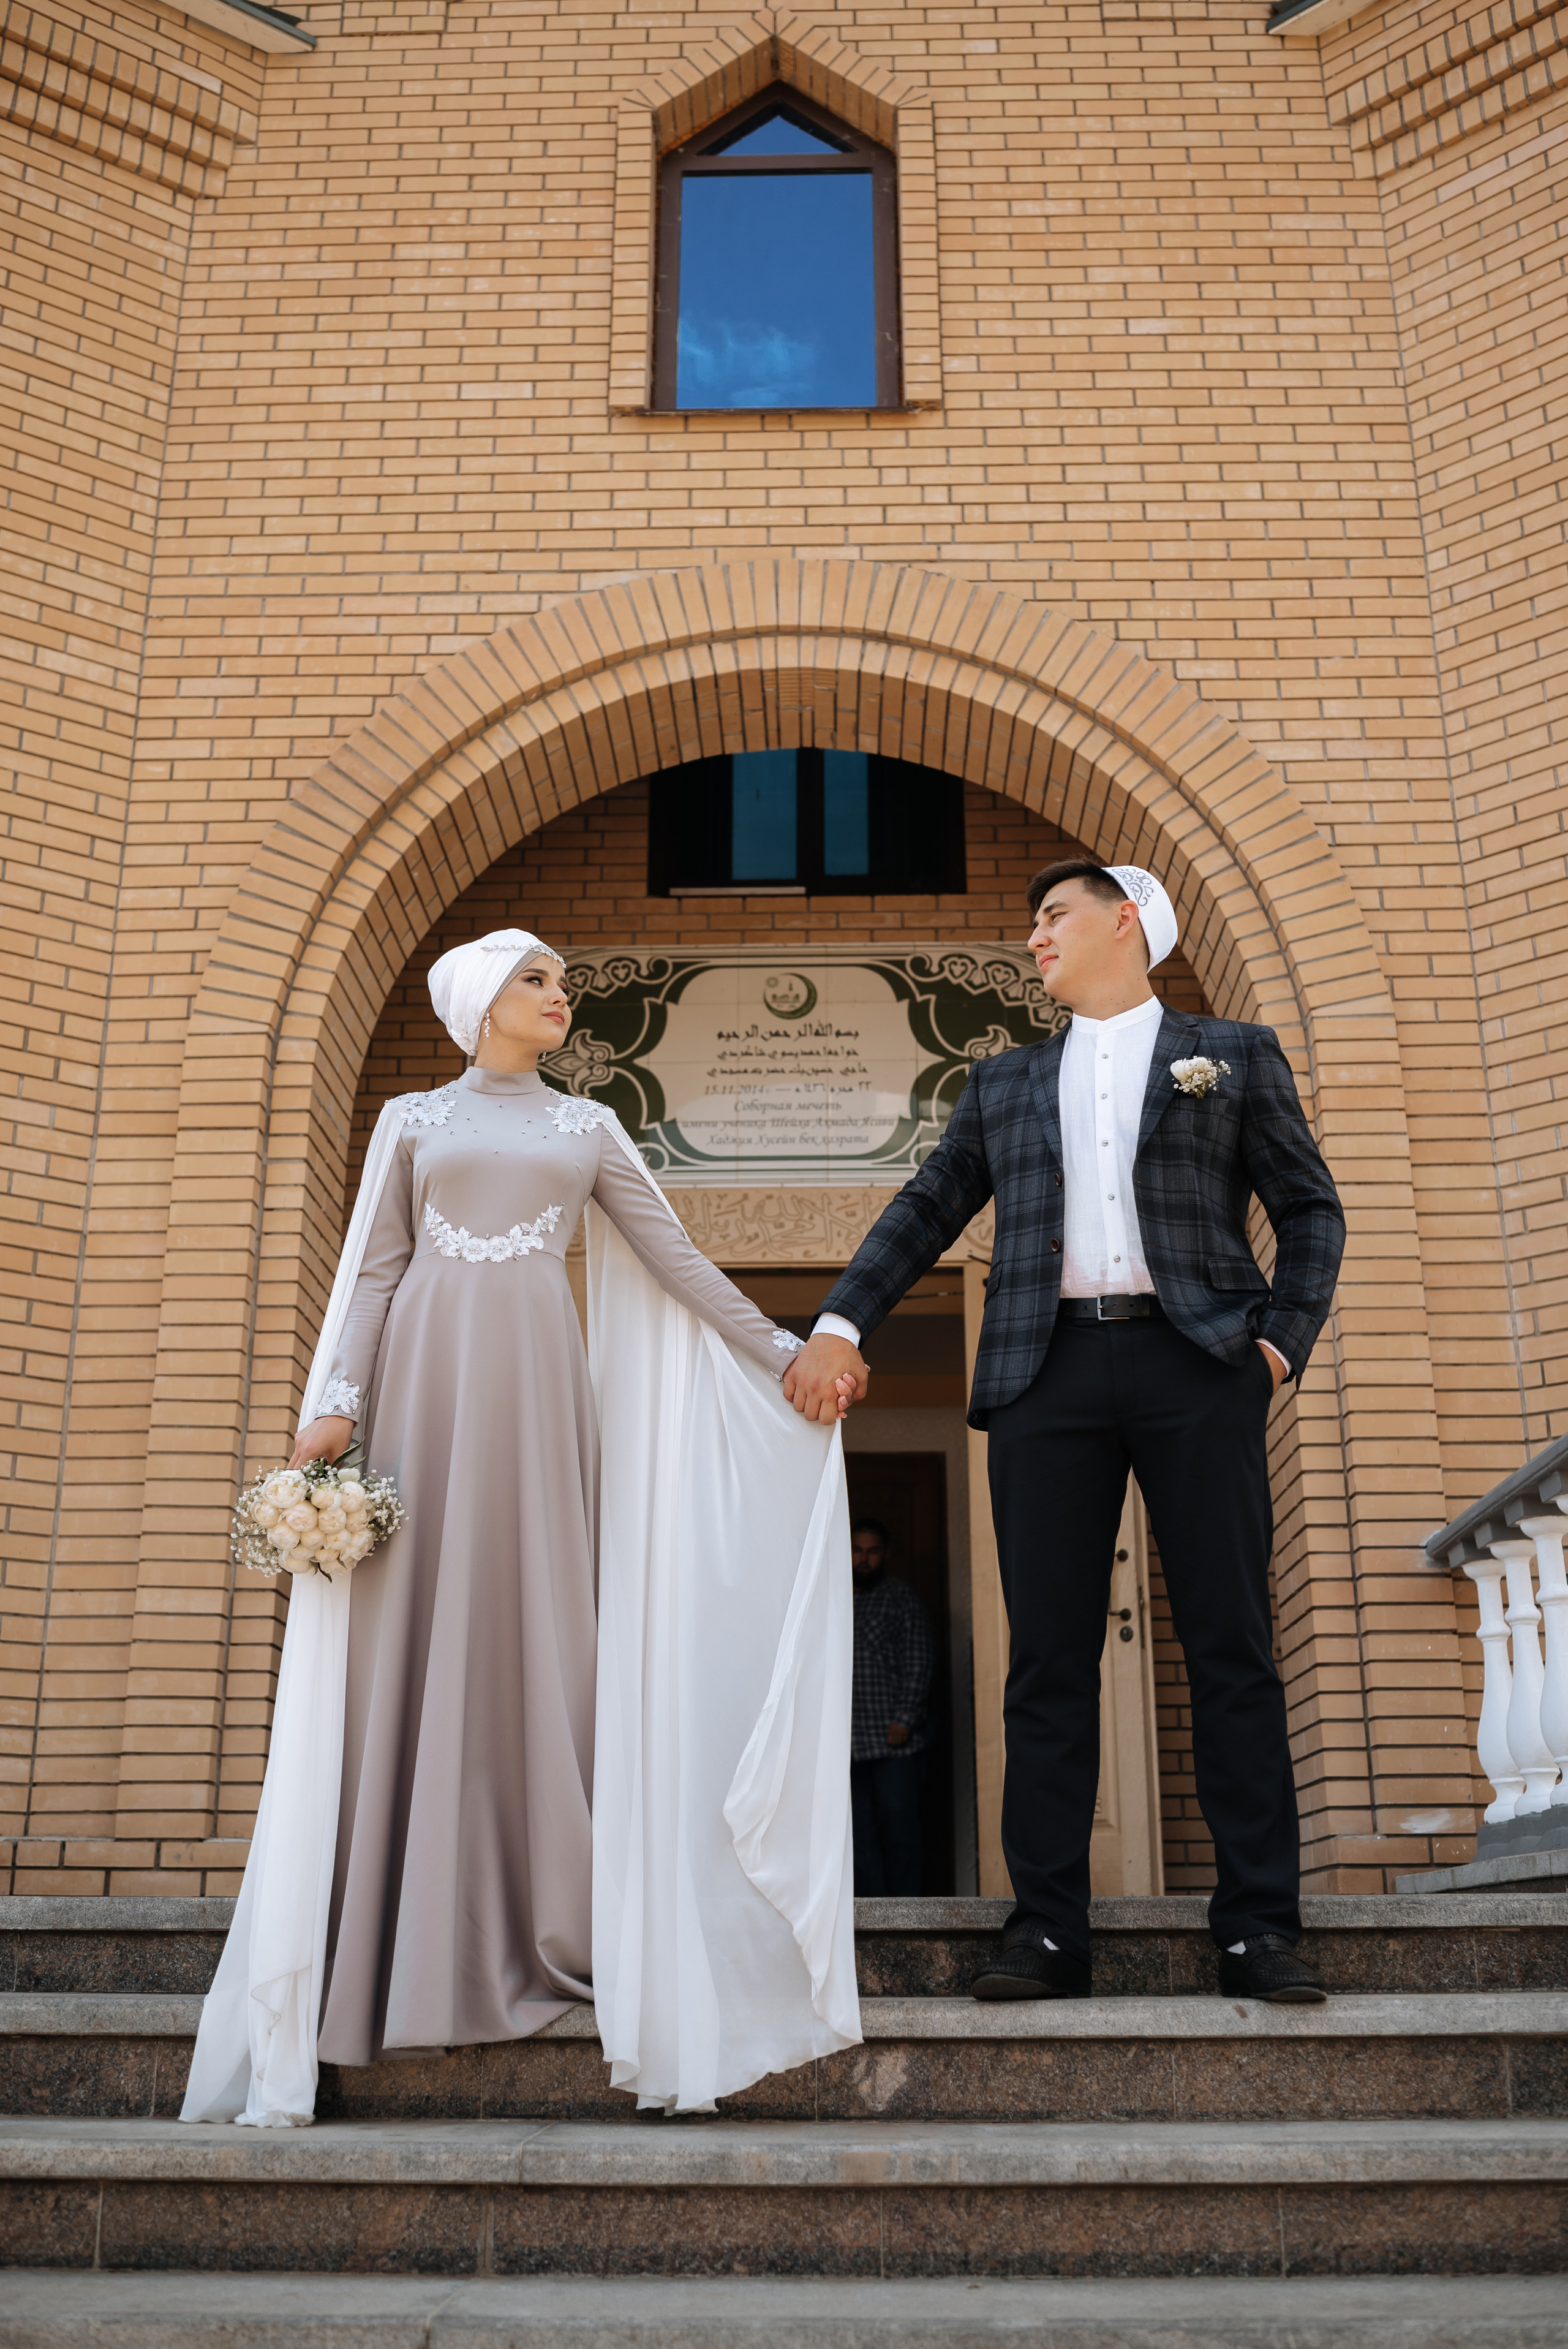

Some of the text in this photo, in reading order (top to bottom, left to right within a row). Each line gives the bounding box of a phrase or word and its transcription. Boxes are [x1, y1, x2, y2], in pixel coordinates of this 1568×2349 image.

[717, 1024, 759, 1042] الرحيم
[813, 1019, 833, 1037] الله
[835, 1029, 859, 1040] بسم
[734, 1098, 843, 1115] Соборная мечеть
